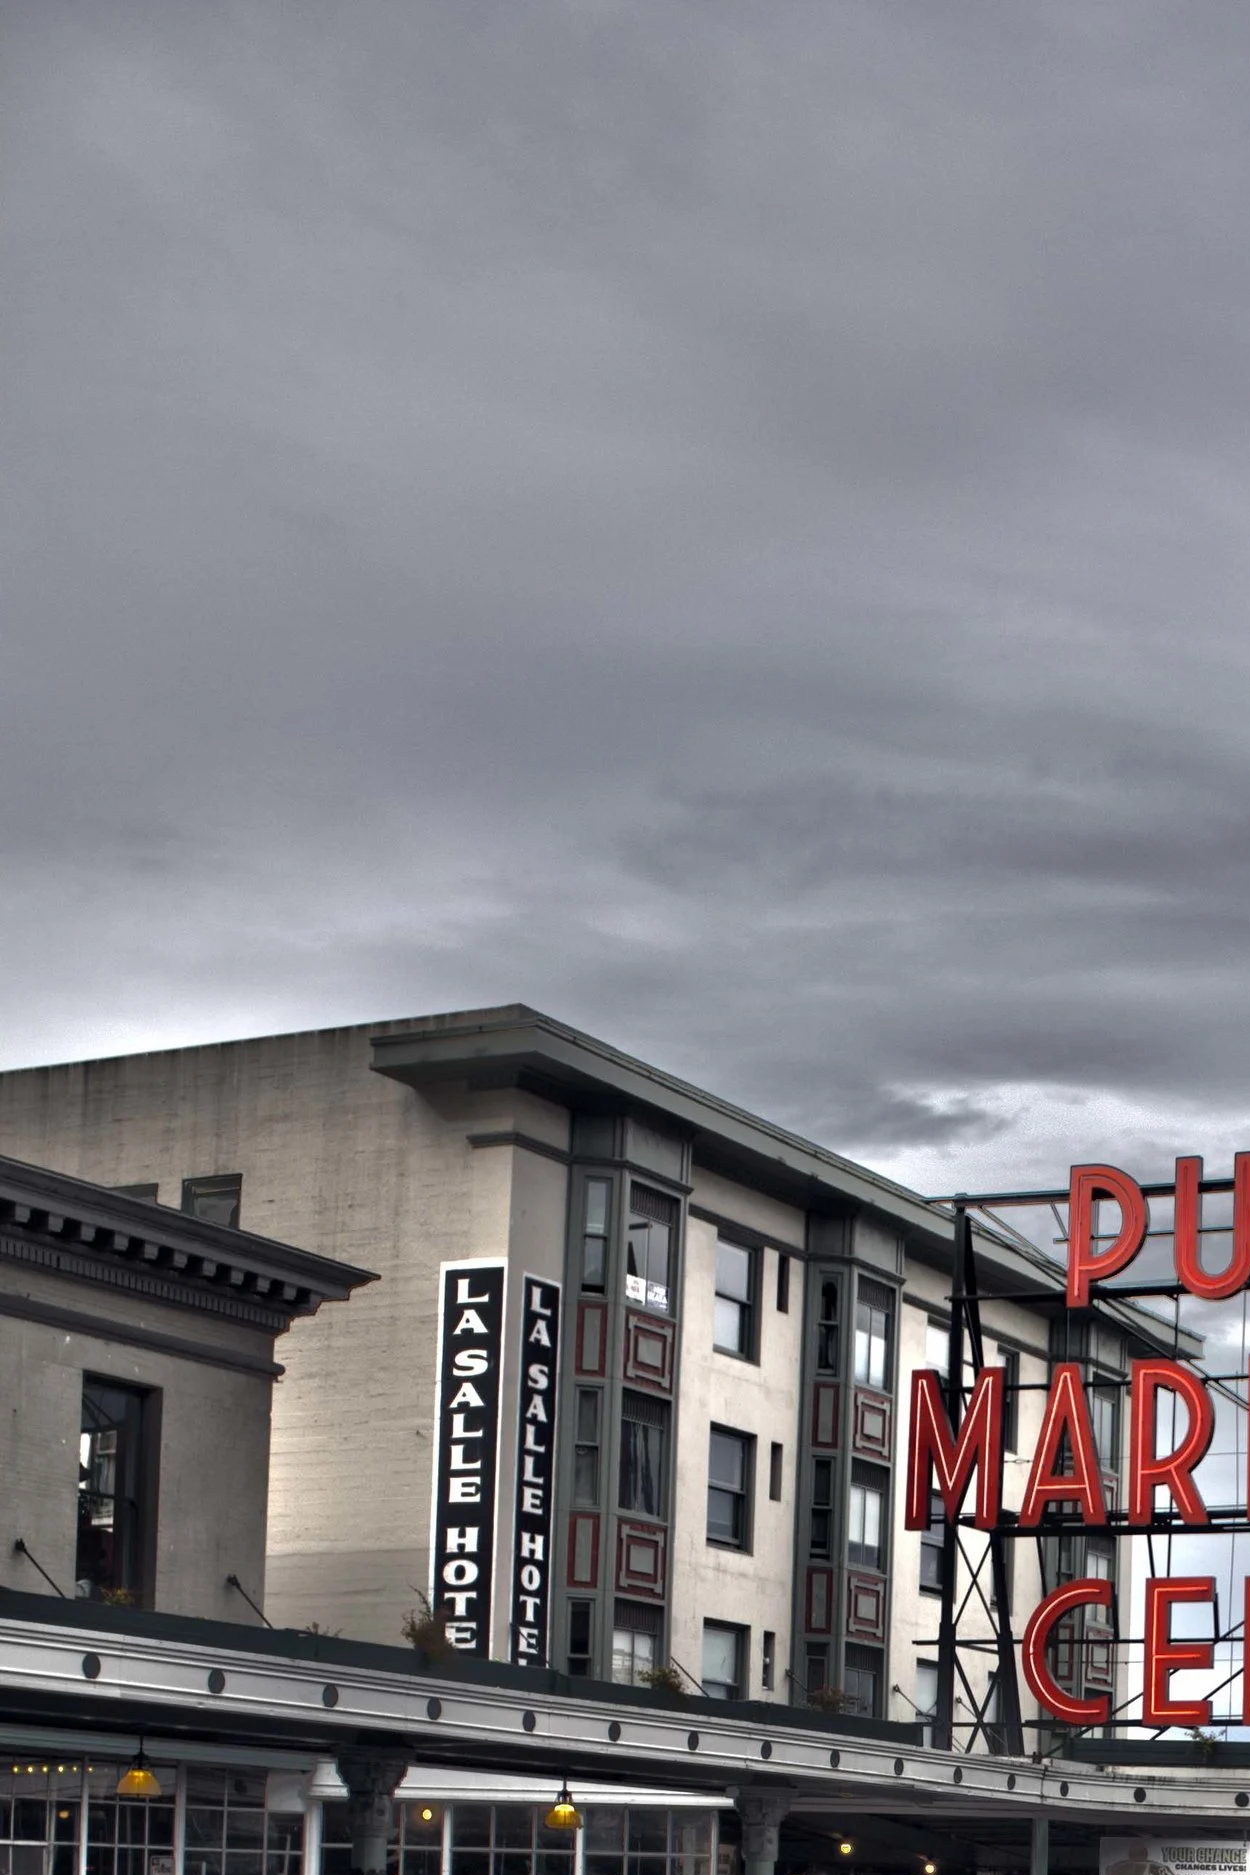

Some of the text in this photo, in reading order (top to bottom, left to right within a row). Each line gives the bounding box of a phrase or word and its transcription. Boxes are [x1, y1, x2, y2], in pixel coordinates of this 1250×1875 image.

[453, 1278, 489, 1335] LA
[449, 1349, 489, 1503] SALLE
[517, 1286, 552, 1666] LA SALLE HOTE
[1161, 1847, 1248, 1864] YOUR CHANGE
[1175, 1863, 1217, 1871] CHANGES
